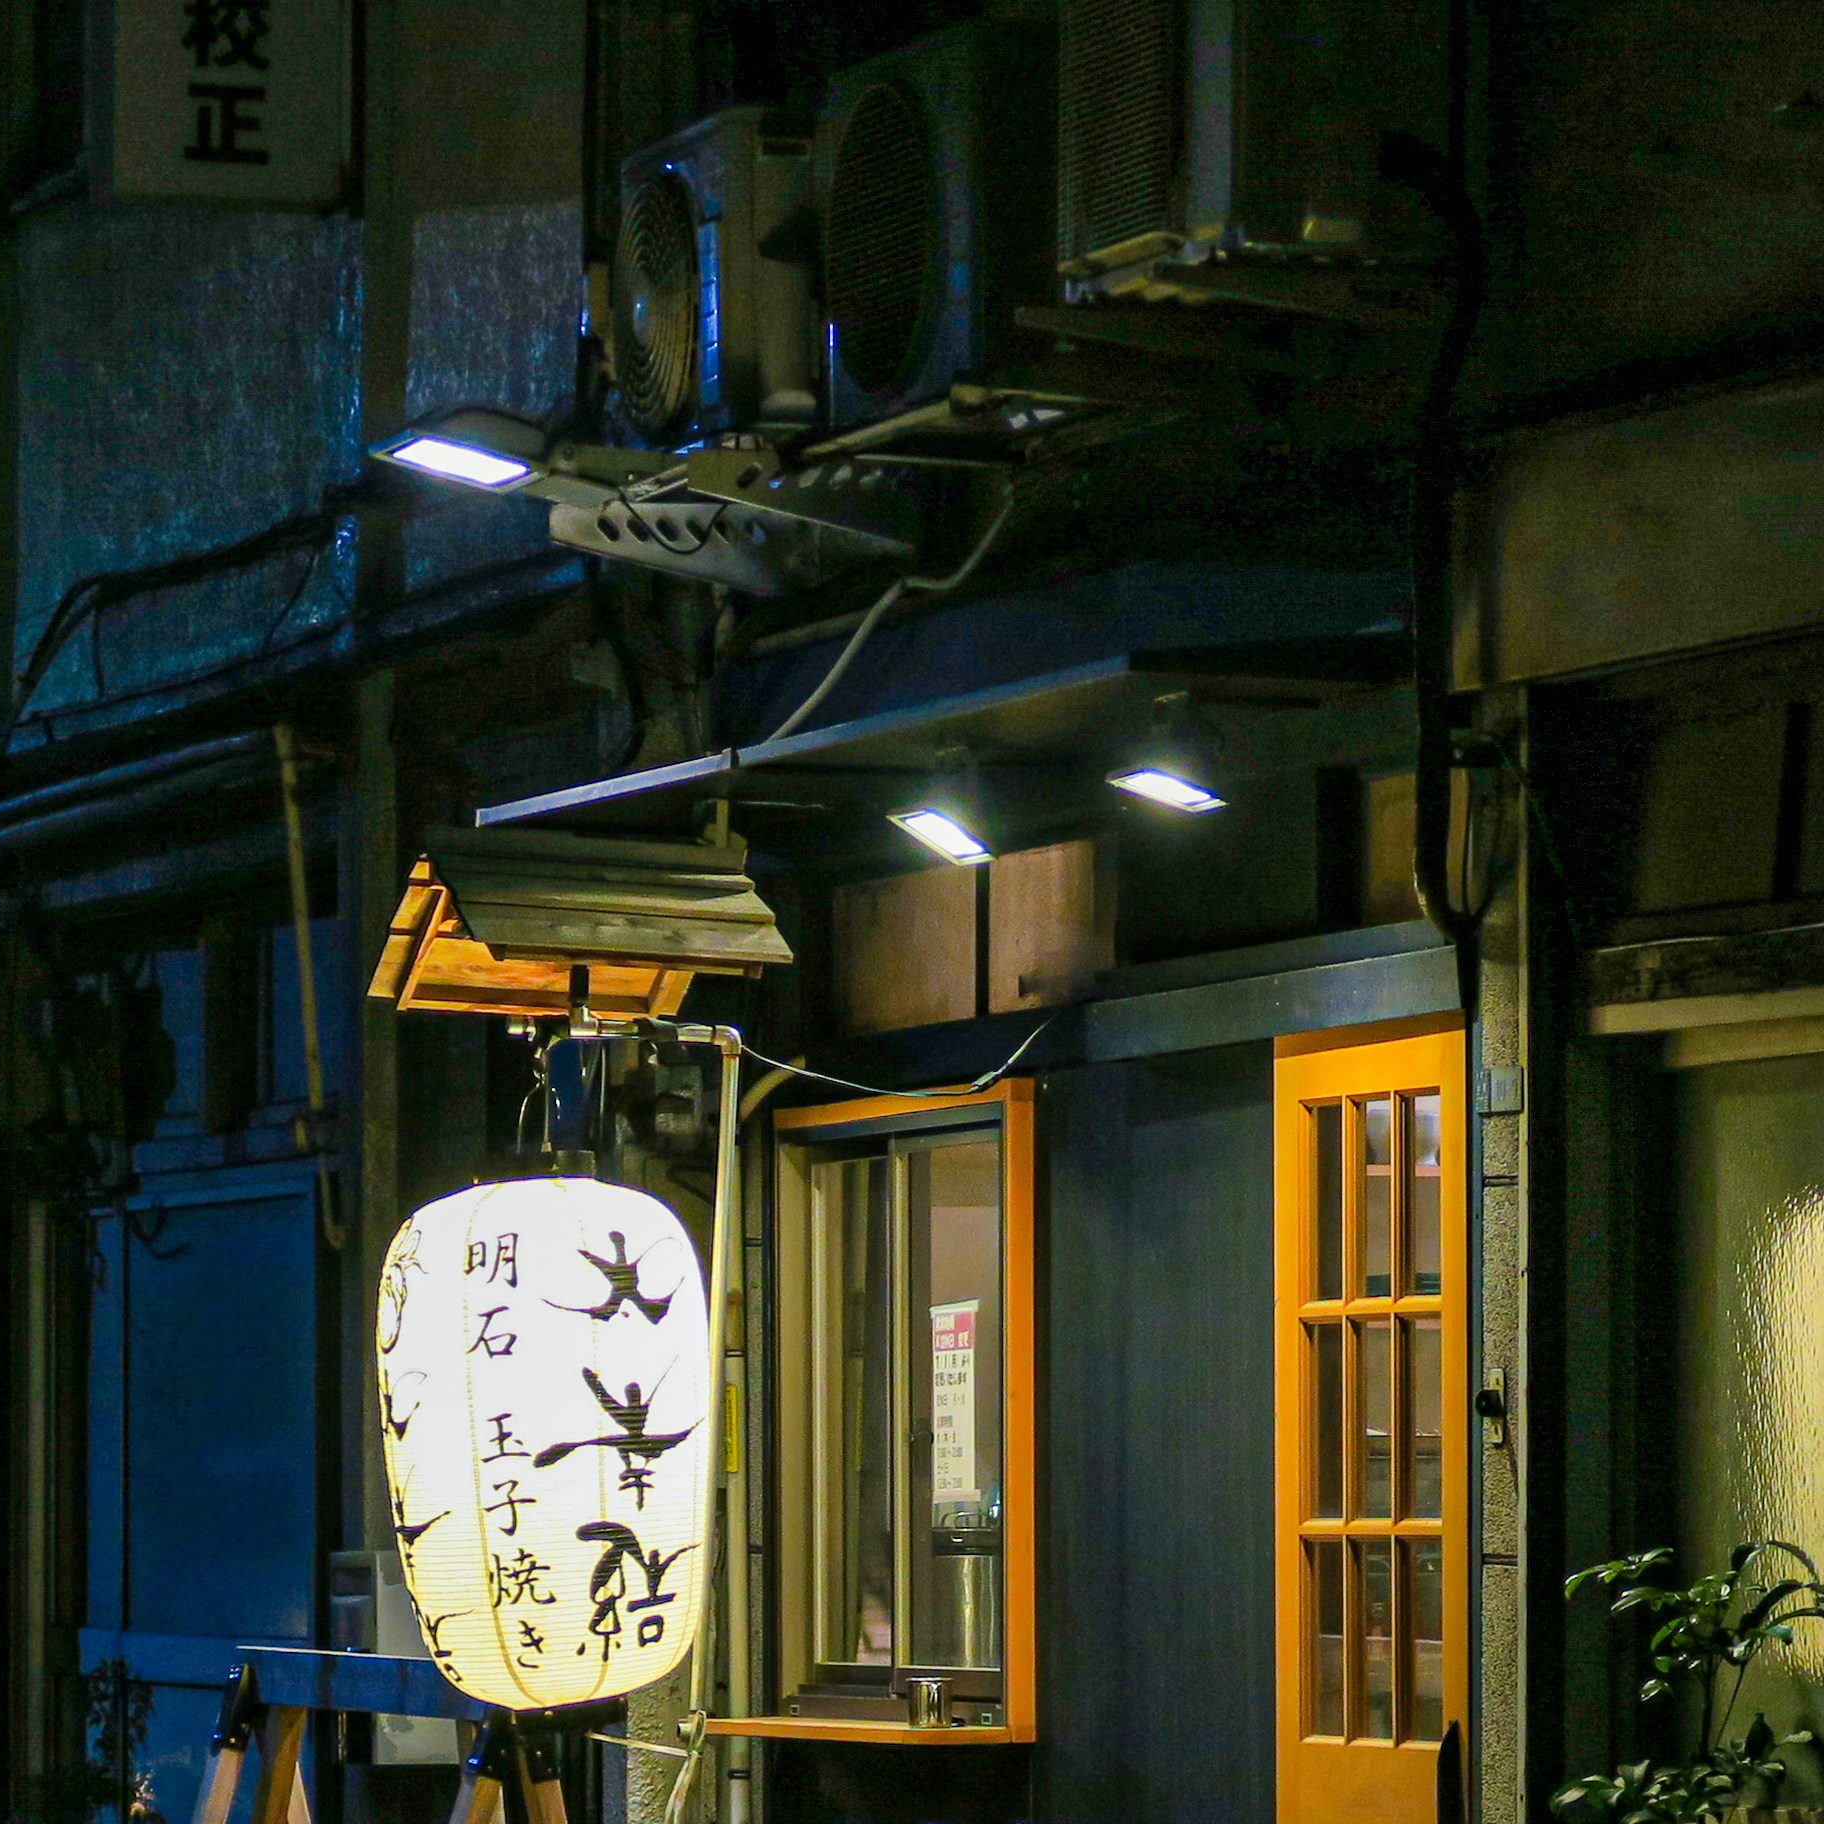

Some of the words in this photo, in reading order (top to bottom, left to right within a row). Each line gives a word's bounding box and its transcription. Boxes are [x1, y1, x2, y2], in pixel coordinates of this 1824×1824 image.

[466, 1232, 520, 1358] 明石
[482, 1412, 557, 1668] 玉子焼き
